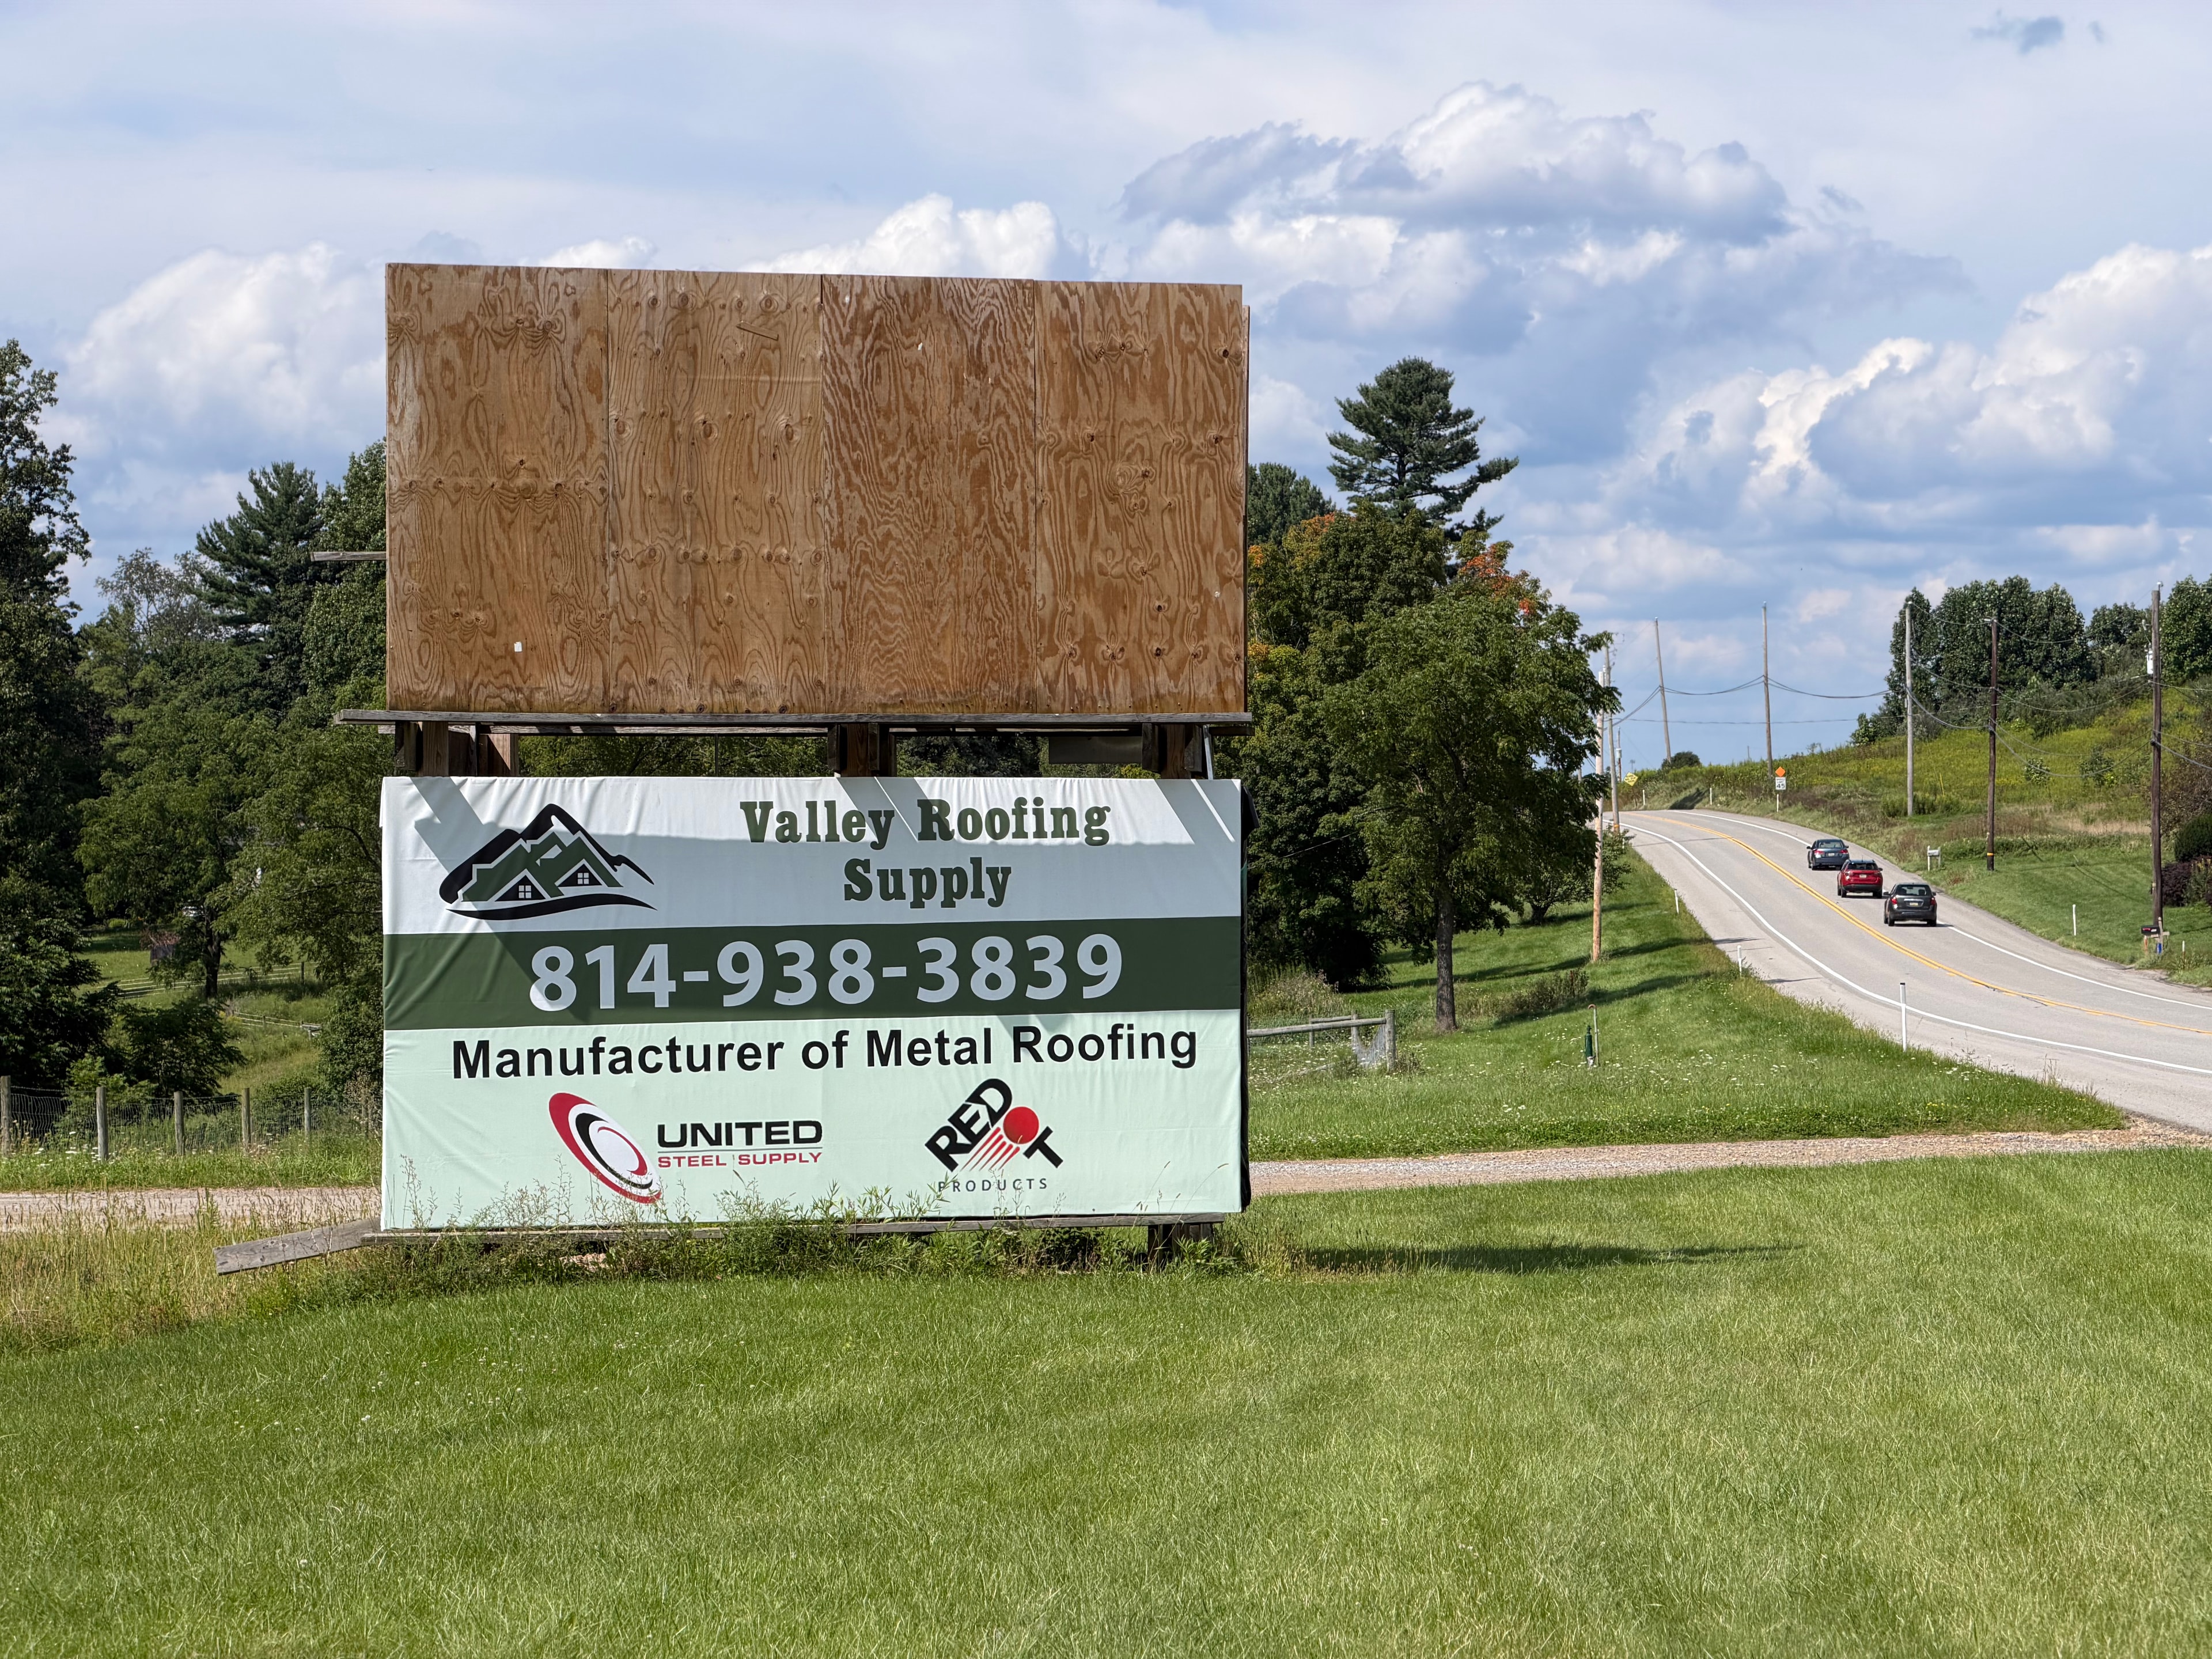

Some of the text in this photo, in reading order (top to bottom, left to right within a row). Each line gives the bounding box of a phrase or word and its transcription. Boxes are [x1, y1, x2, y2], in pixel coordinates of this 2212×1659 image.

[740, 797, 1112, 851] Valley Roofing
[843, 856, 1012, 909] Supply
[529, 933, 1123, 1012] 814-938-3839
[453, 1022, 1197, 1080] Manufacturer of Metal Roofing
[657, 1120, 823, 1148] UNITED
[658, 1152, 823, 1168] STEEL SUPPLY
[937, 1177, 1048, 1192] PRODUCTS
